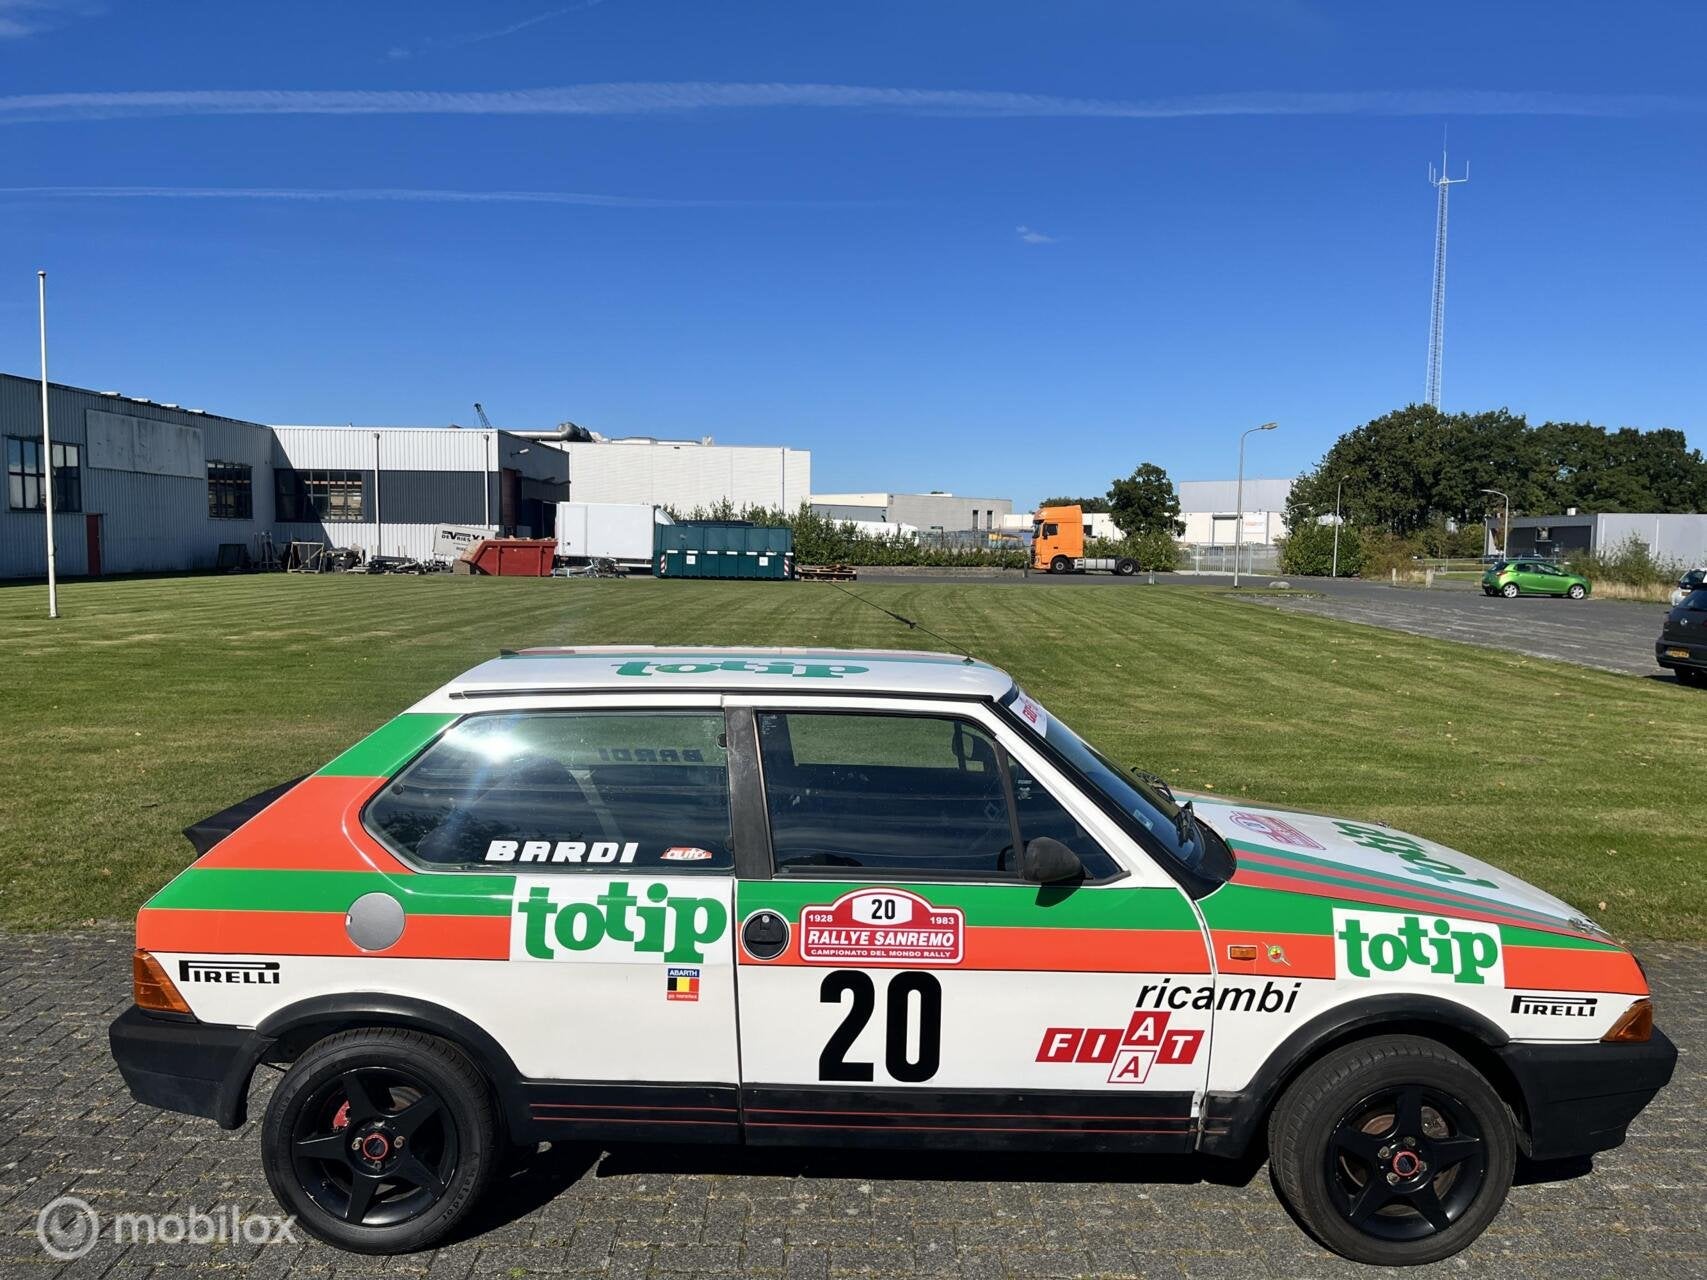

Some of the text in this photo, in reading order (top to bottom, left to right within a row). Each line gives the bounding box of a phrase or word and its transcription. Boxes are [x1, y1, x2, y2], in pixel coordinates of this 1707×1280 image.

[611, 660, 870, 679] totip
[484, 840, 639, 863] BARDI
[808, 914, 833, 923] 1928
[871, 899, 896, 920] 20
[518, 882, 728, 964] totip
[930, 916, 955, 925] 1983
[808, 930, 955, 947] RALLYE SANREMO
[810, 949, 951, 958] CAMPIONATO DEL MONDO RALLY
[1338, 916, 1498, 985] totip
[179, 960, 280, 984] PIRELLI
[669, 969, 698, 977] ABARTH
[1135, 977, 1302, 1014] ricambi
[1510, 995, 1598, 1017] PIRELLI
[819, 970, 942, 1083] 20
